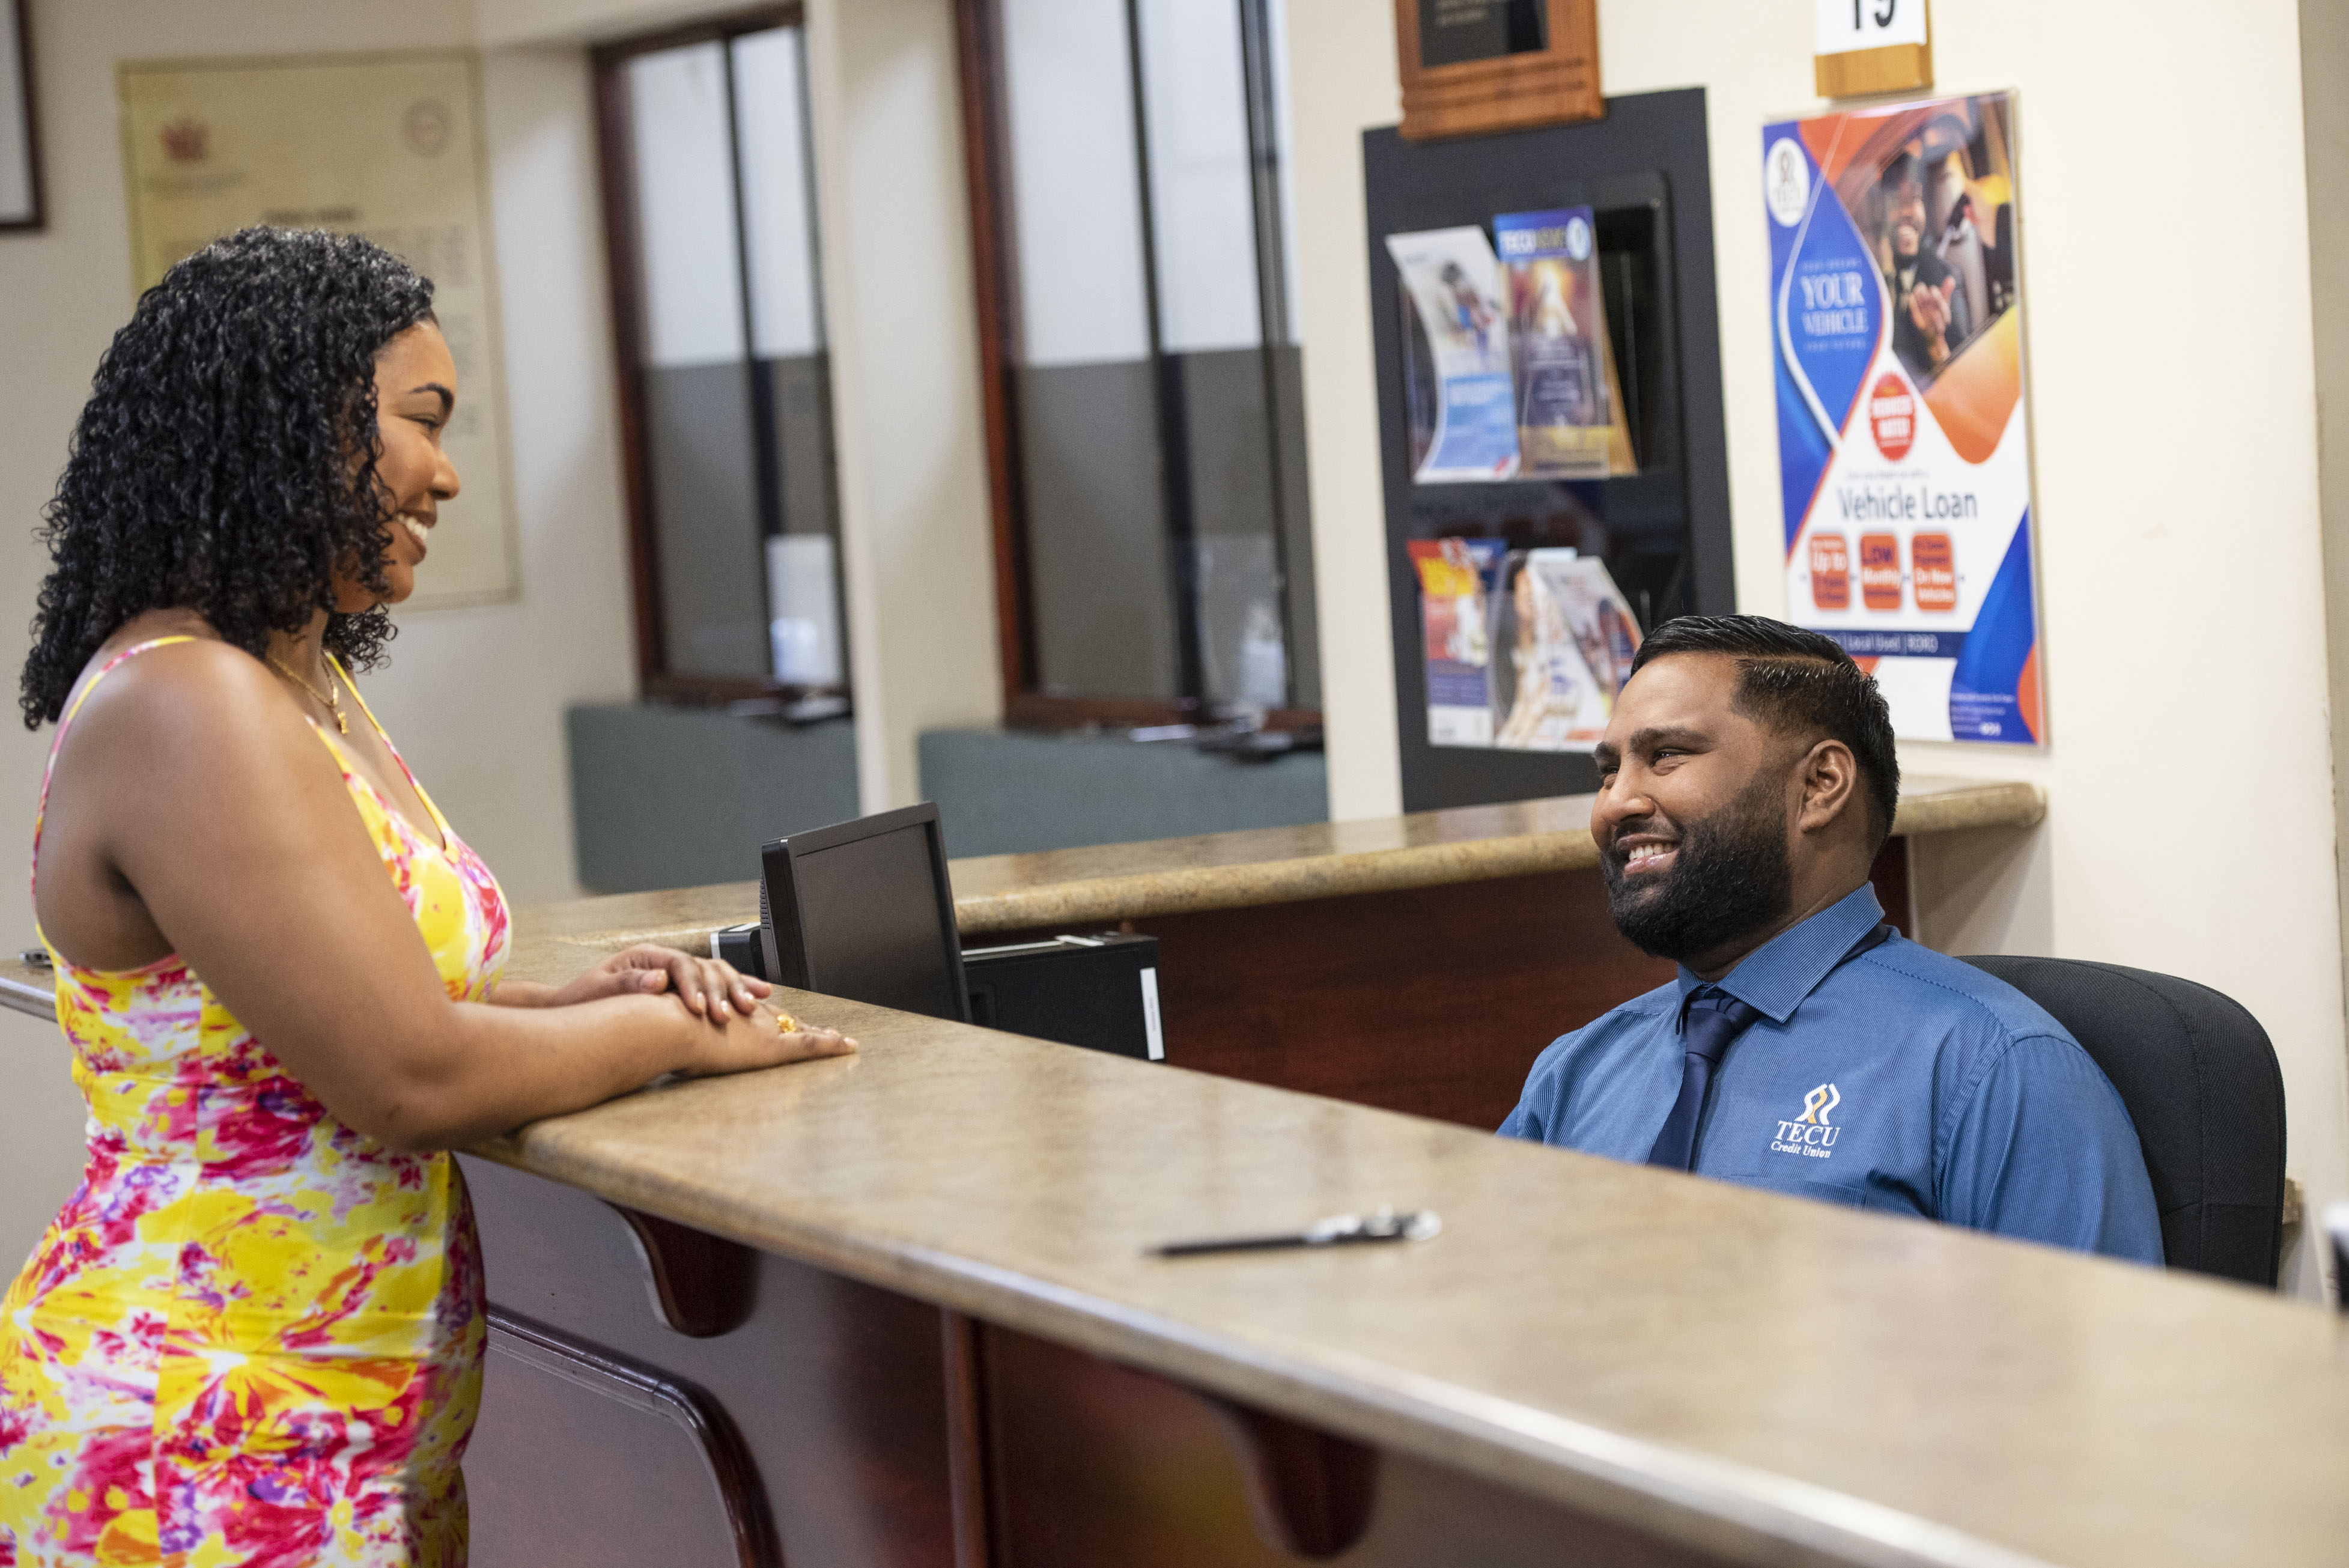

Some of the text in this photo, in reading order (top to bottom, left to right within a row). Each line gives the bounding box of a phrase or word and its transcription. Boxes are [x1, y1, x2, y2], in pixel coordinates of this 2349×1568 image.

[1800, 272, 1865, 309] YOUR
[1802, 308, 1869, 336] VEHICLE
[1836, 485, 1978, 519] Vehicle Loan
[1775, 1120, 1841, 1146] TECU
[1771, 1141, 1831, 1158] Credit Union
